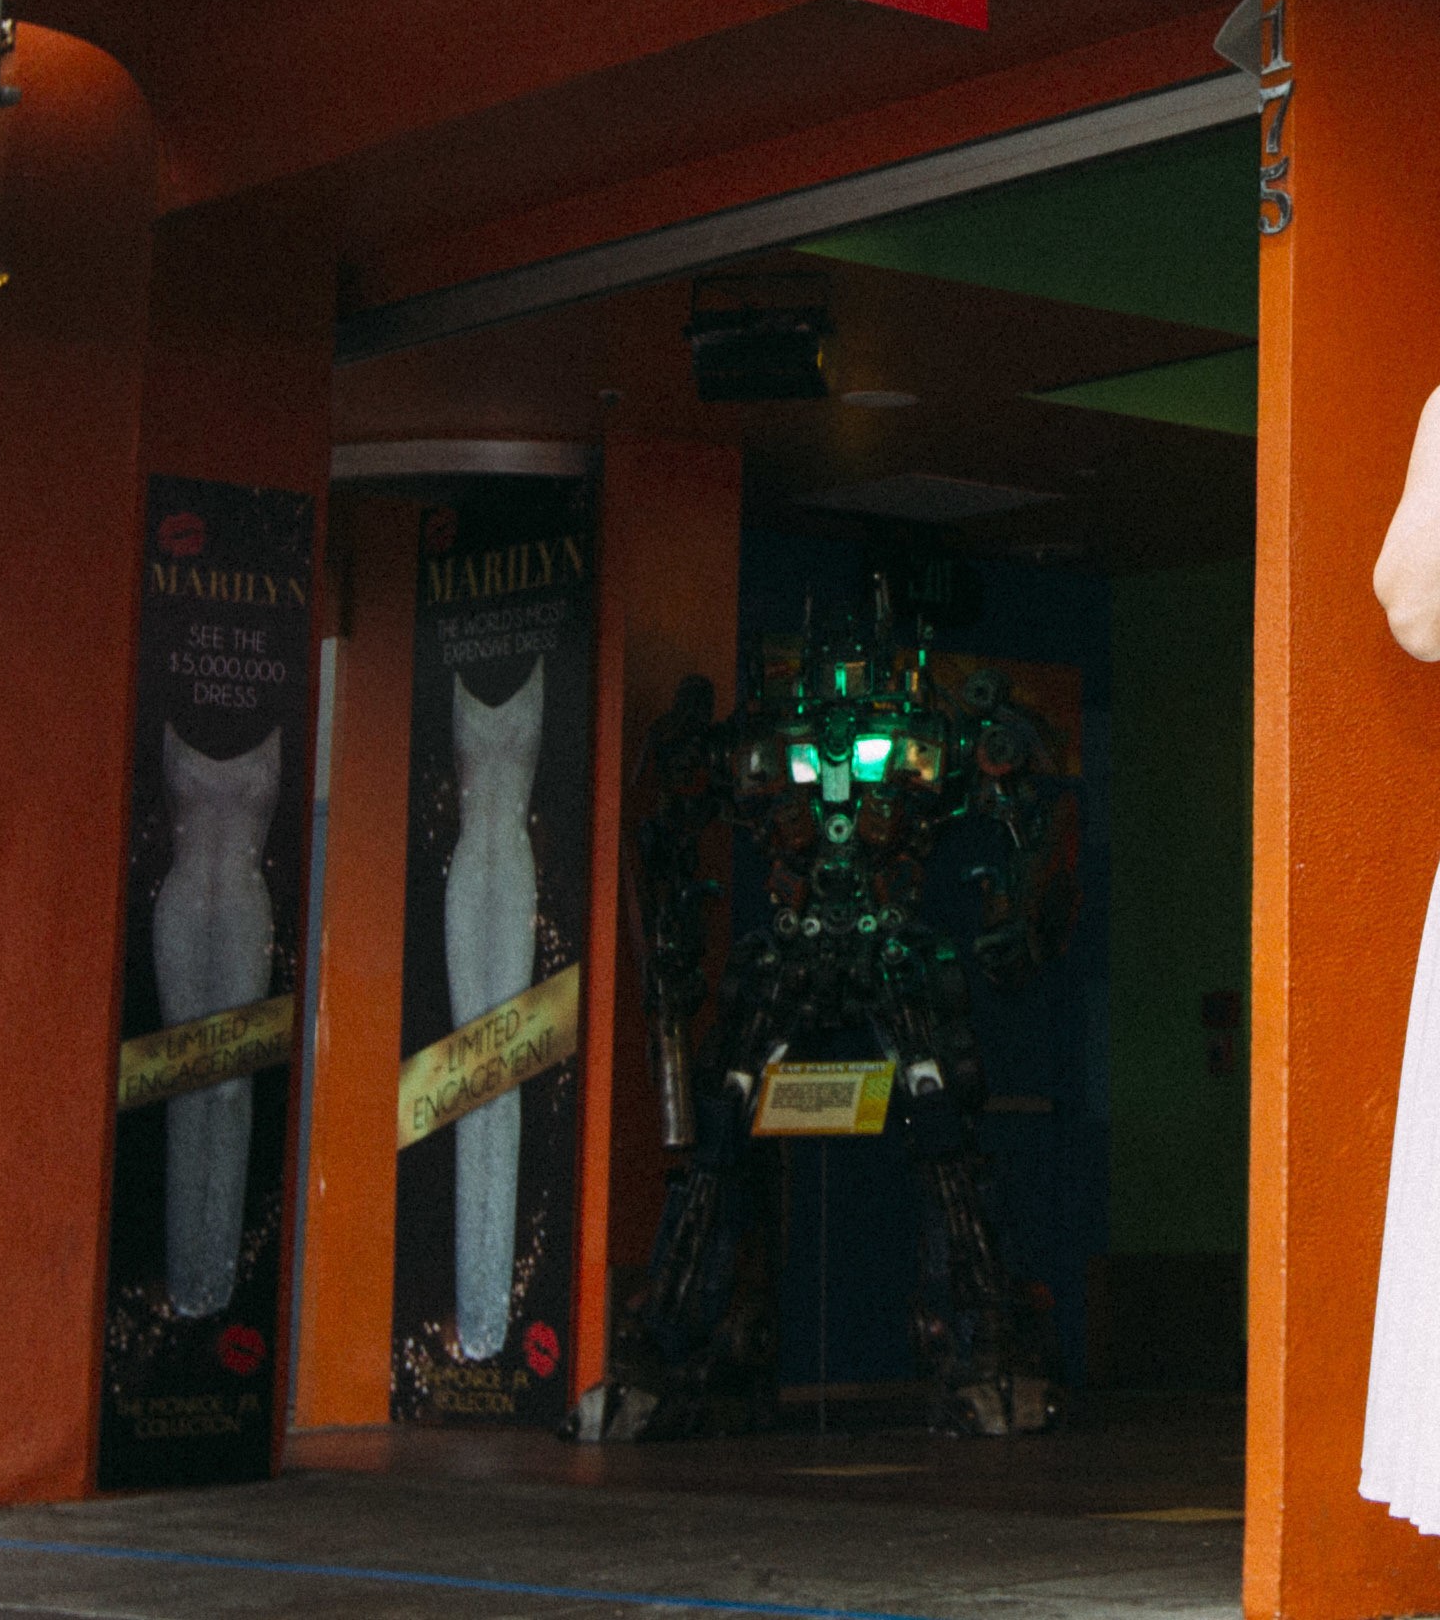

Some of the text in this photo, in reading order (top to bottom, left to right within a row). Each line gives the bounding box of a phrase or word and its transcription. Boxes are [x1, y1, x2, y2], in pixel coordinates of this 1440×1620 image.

[149, 561, 308, 608] MARILYN
[426, 533, 586, 607] MARILYN
[188, 623, 268, 654] SEE THE
[192, 681, 259, 710] DRESS
